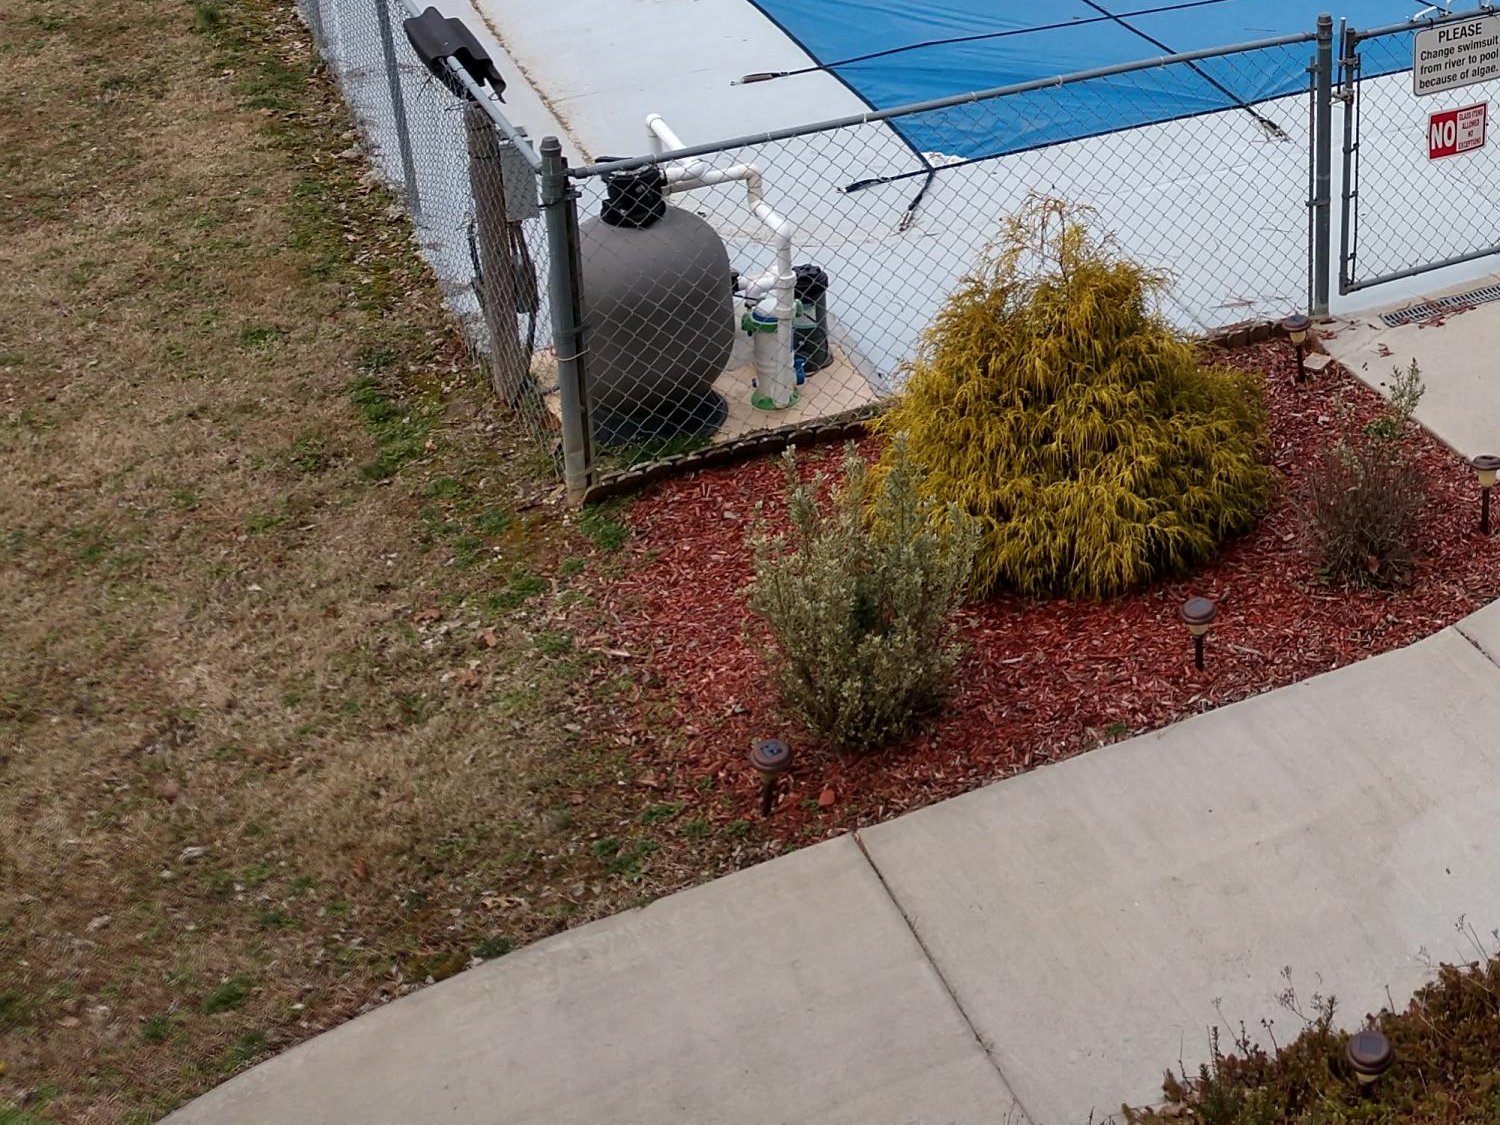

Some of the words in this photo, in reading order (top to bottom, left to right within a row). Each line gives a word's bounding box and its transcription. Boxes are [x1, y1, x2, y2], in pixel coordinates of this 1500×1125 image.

[1438, 23, 1482, 43] PLEASE
[1420, 47, 1455, 61] Change
[1457, 36, 1499, 53] swimsuit
[1420, 63, 1442, 75] from
[1444, 57, 1466, 70] river
[1468, 55, 1477, 64] to
[1480, 48, 1499, 64] pool
[1419, 74, 1457, 89] because
[1460, 68, 1469, 80] of
[1471, 64, 1499, 78] algae.
[1431, 120, 1456, 150] NO
